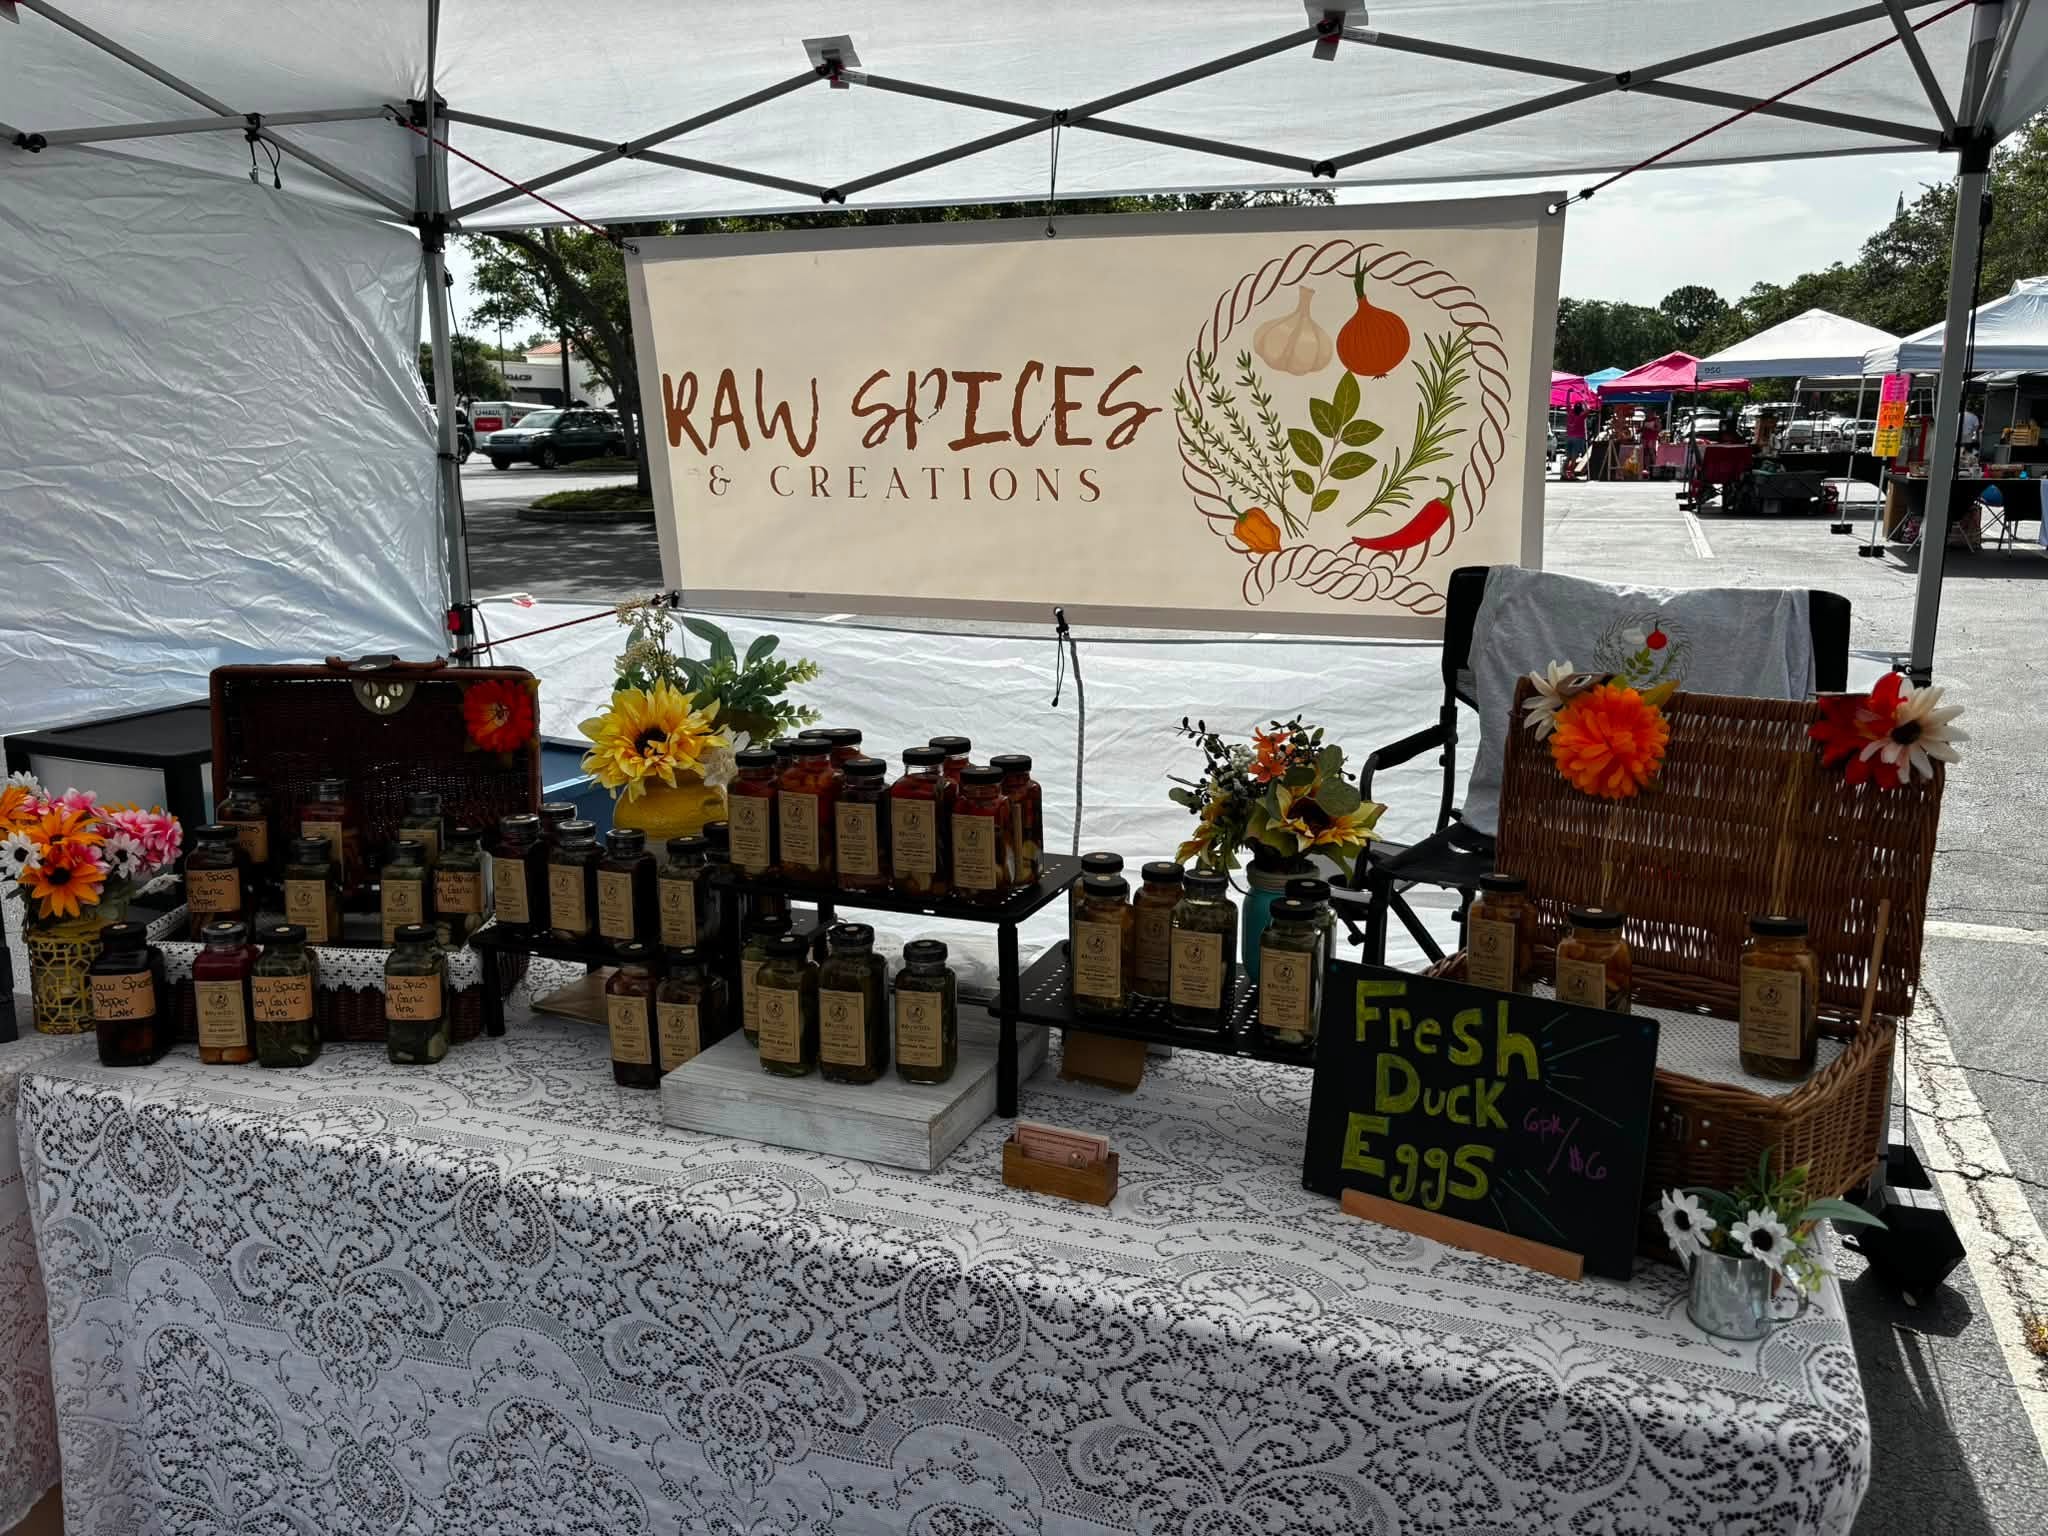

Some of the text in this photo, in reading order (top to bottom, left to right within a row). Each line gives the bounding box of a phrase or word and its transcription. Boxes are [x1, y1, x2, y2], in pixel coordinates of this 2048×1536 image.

[661, 360, 1164, 459] RAW SPICES
[708, 465, 1101, 503] & CREATIONS
[1355, 979, 1540, 1081] Fresh
[1341, 1111, 1495, 1211] Eggs
